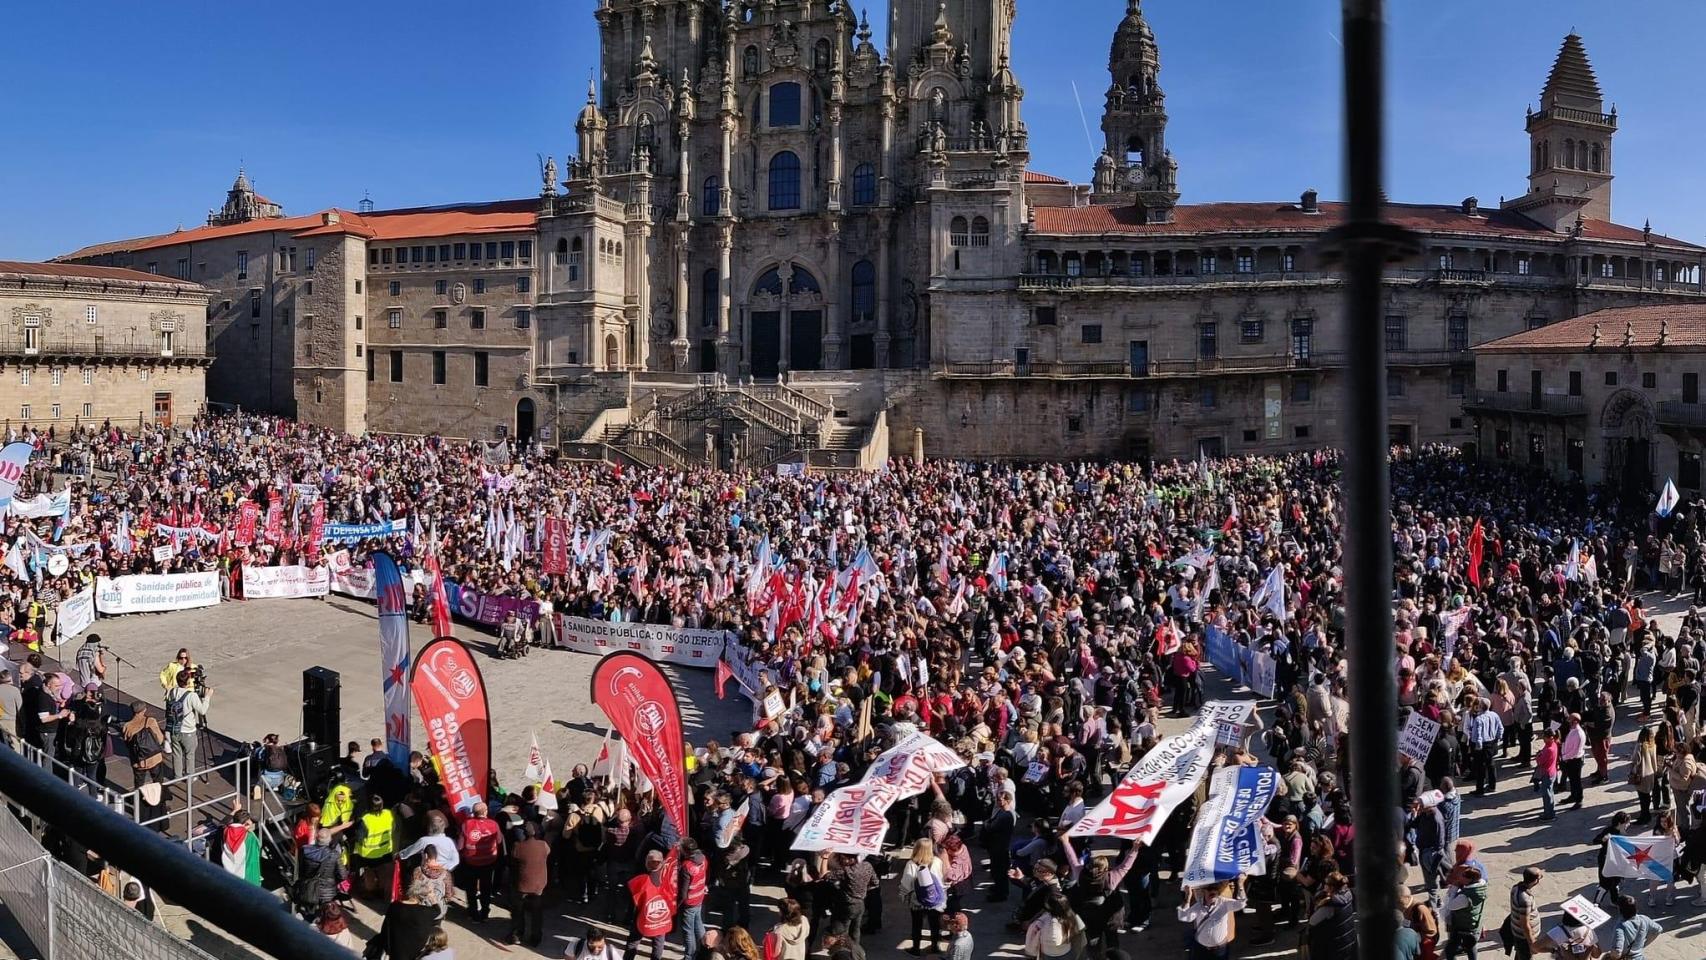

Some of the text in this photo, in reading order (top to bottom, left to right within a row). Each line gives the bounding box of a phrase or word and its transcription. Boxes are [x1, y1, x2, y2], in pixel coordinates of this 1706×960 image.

[550, 519, 561, 561] UGT
[567, 622, 609, 636] SANIDADE
[610, 624, 654, 640] PÚBLICA:
[656, 631, 662, 641] O
[665, 632, 690, 645] NOSO
[1407, 723, 1434, 745] PERSOAL
[1415, 718, 1435, 733] SEN
[810, 801, 831, 829] Cangas
[1094, 778, 1168, 836] XA!
[1580, 913, 1595, 925] EU
